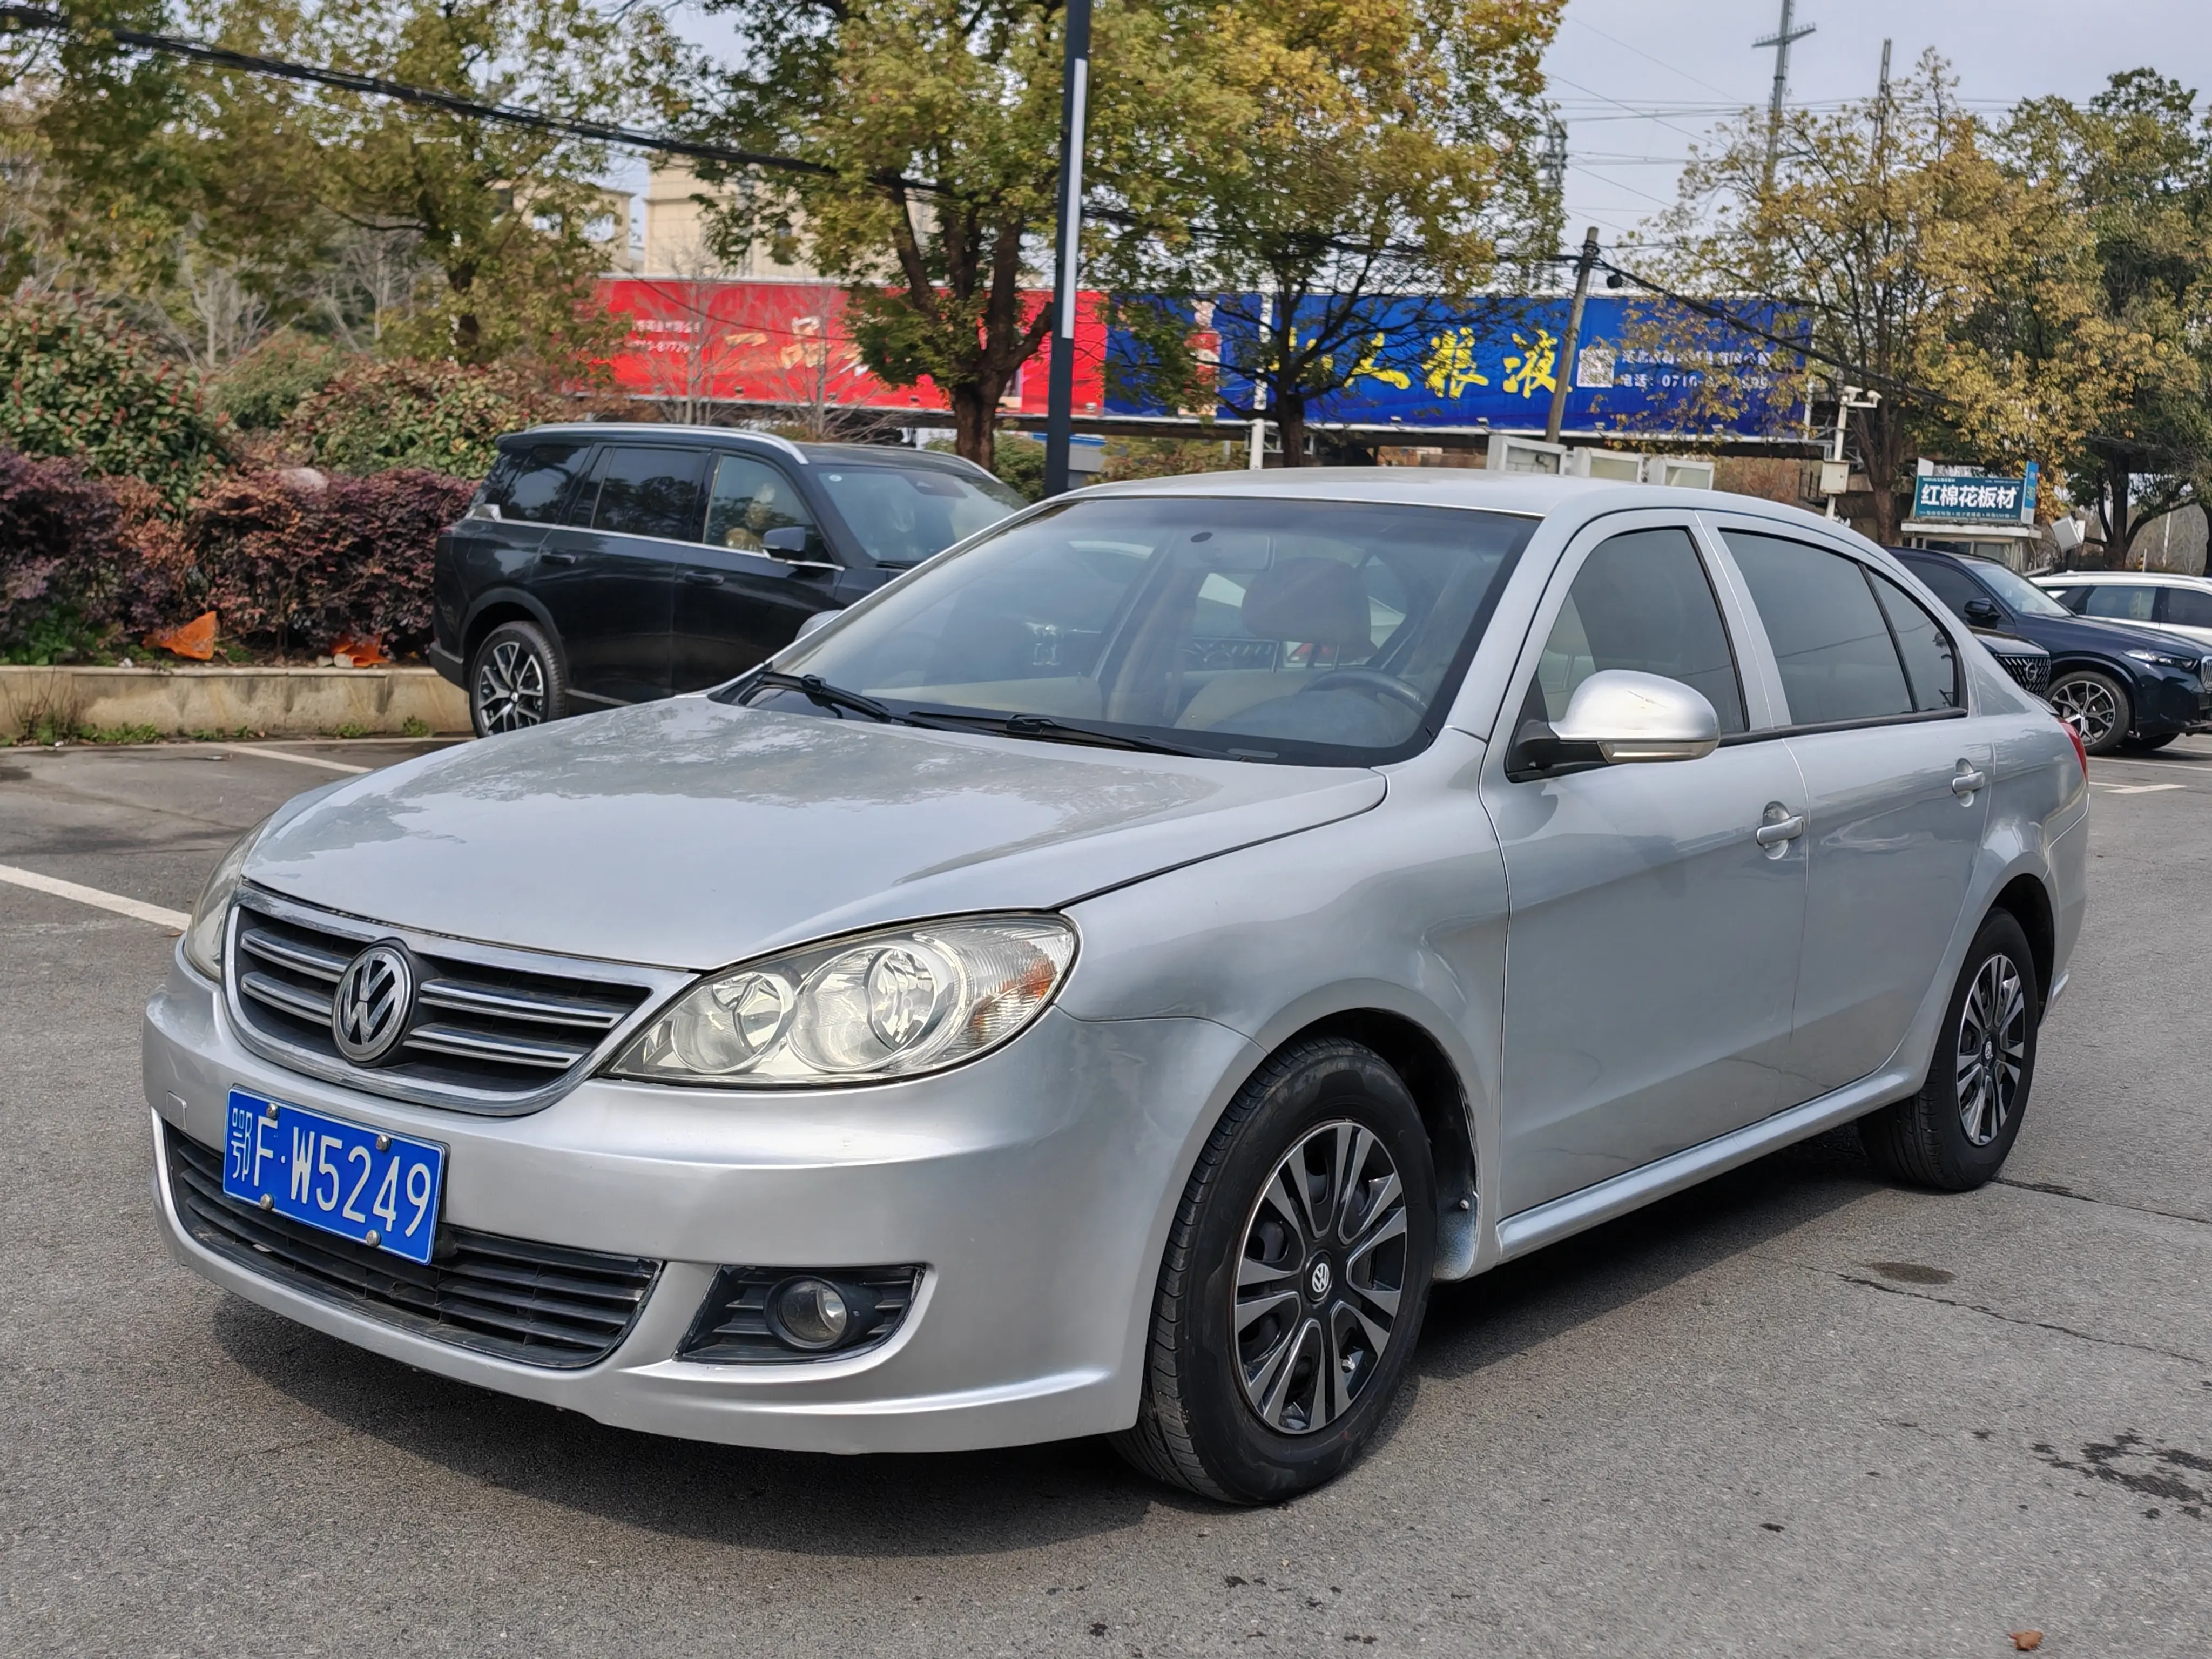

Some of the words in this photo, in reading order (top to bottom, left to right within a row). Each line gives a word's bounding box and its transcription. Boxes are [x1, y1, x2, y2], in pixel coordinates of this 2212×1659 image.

[1921, 483, 2017, 509] 红棉花板材
